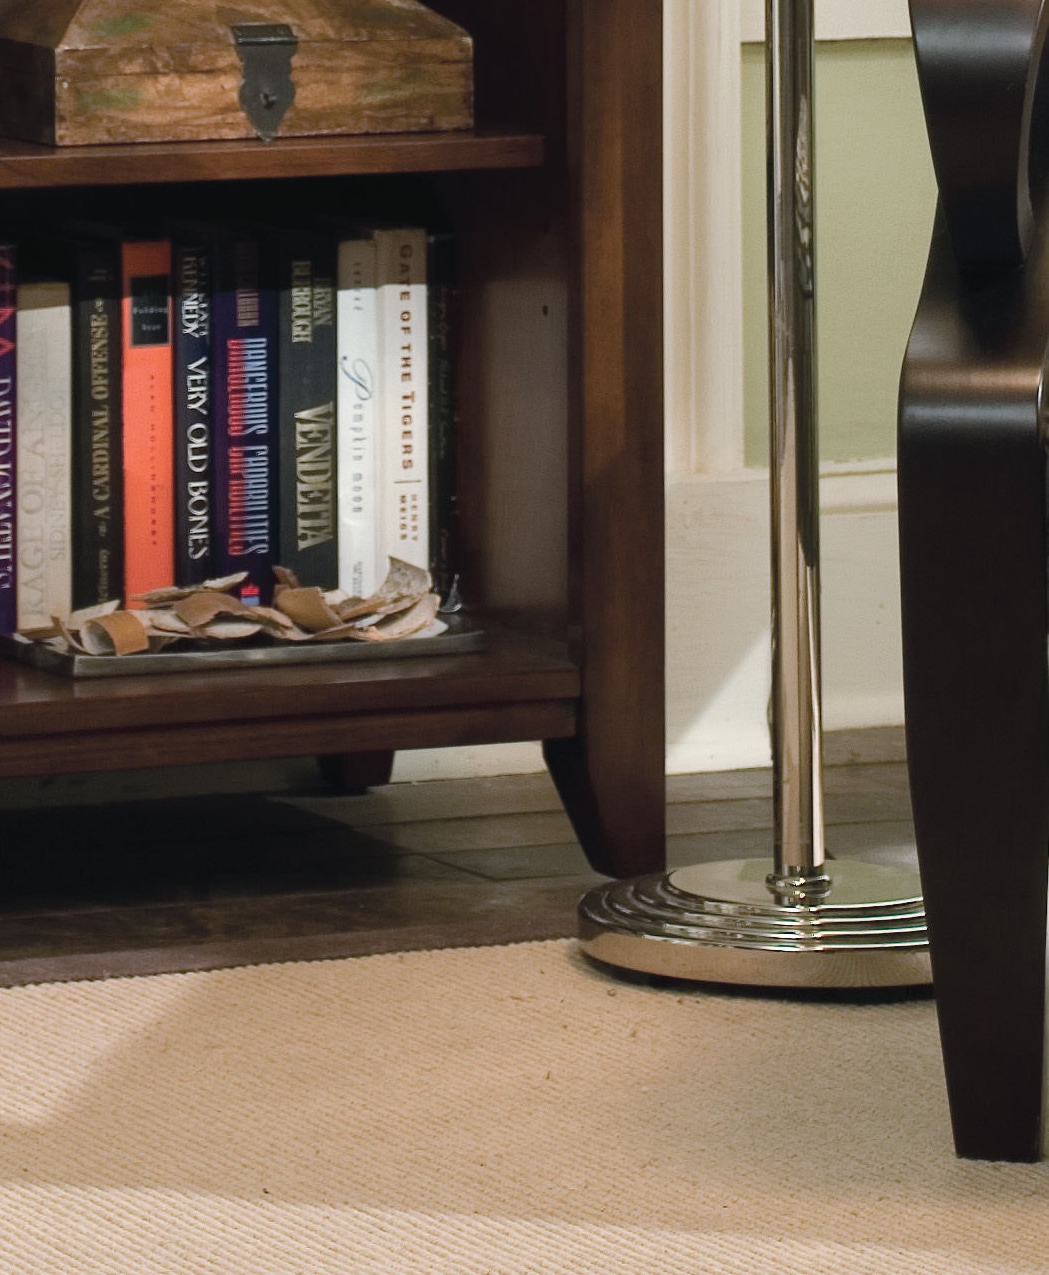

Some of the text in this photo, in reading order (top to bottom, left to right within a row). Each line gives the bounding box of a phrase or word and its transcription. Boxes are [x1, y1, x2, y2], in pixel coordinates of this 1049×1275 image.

[89, 313, 110, 400] OFFENSE
[228, 337, 268, 437] DANGEROUS
[400, 244, 416, 470] GATE OF THE TIGERS
[91, 408, 110, 501] CARDINAL
[186, 356, 210, 560] VERY OLD BONES
[228, 445, 269, 556] CAPABILITIES
[294, 401, 334, 552] VENDETTA
[92, 506, 110, 520] A
